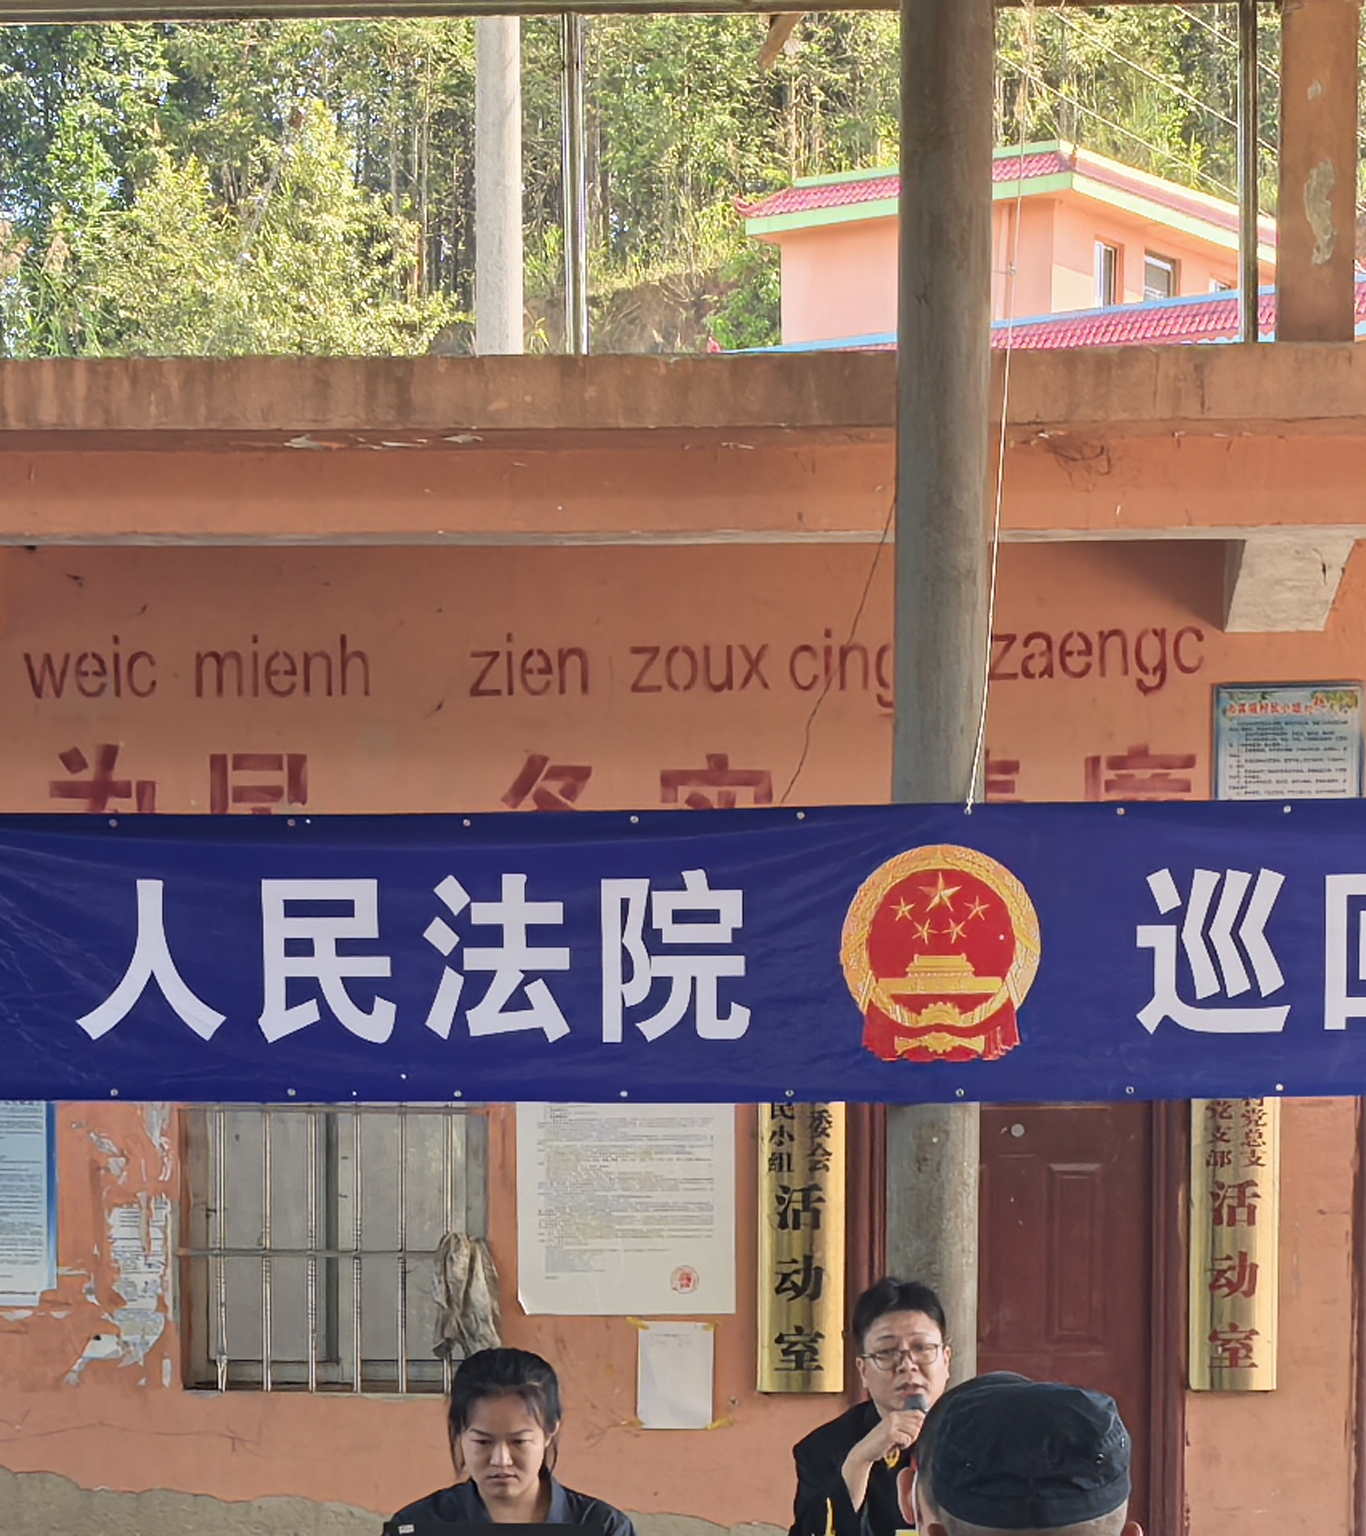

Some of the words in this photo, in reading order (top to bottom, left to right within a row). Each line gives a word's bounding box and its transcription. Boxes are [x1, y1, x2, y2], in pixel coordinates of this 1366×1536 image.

[23, 635, 158, 700] weic
[194, 634, 371, 698] mienh
[469, 632, 590, 697] zien
[629, 642, 770, 695] zoux
[988, 625, 1205, 697] zaengc
[75, 868, 752, 1045] 人民法院
[1239, 1096, 1268, 1169] 党总支
[774, 1182, 826, 1372] 活动室
[1208, 1179, 1262, 1369] 活动室
